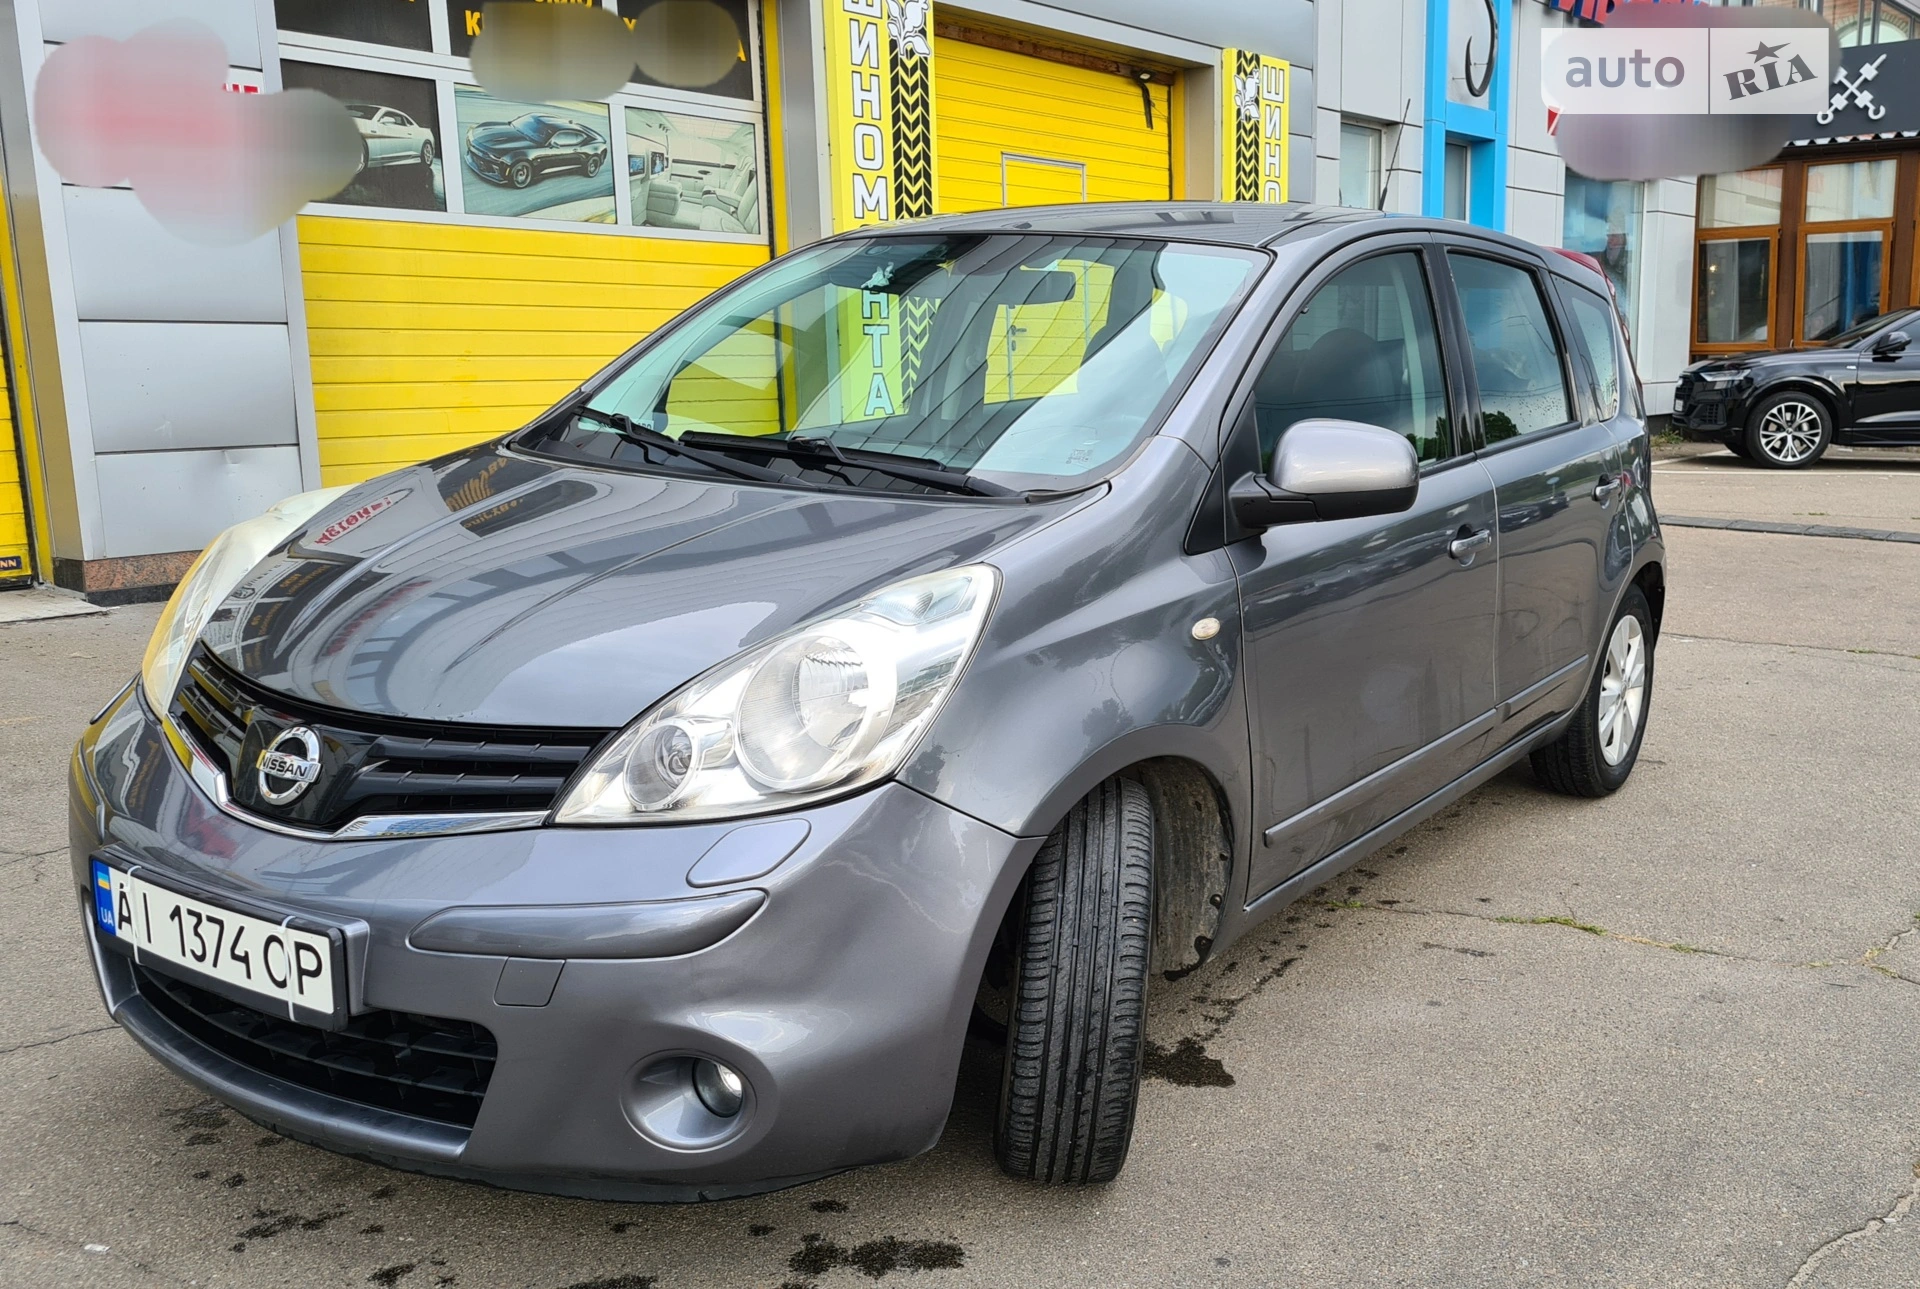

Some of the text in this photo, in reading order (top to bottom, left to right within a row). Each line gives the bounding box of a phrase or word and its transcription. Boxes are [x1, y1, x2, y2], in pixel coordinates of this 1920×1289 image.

[259, 754, 308, 777] NISSAN
[101, 906, 114, 927] UA
[118, 889, 152, 944] AI
[169, 904, 252, 980] 1374
